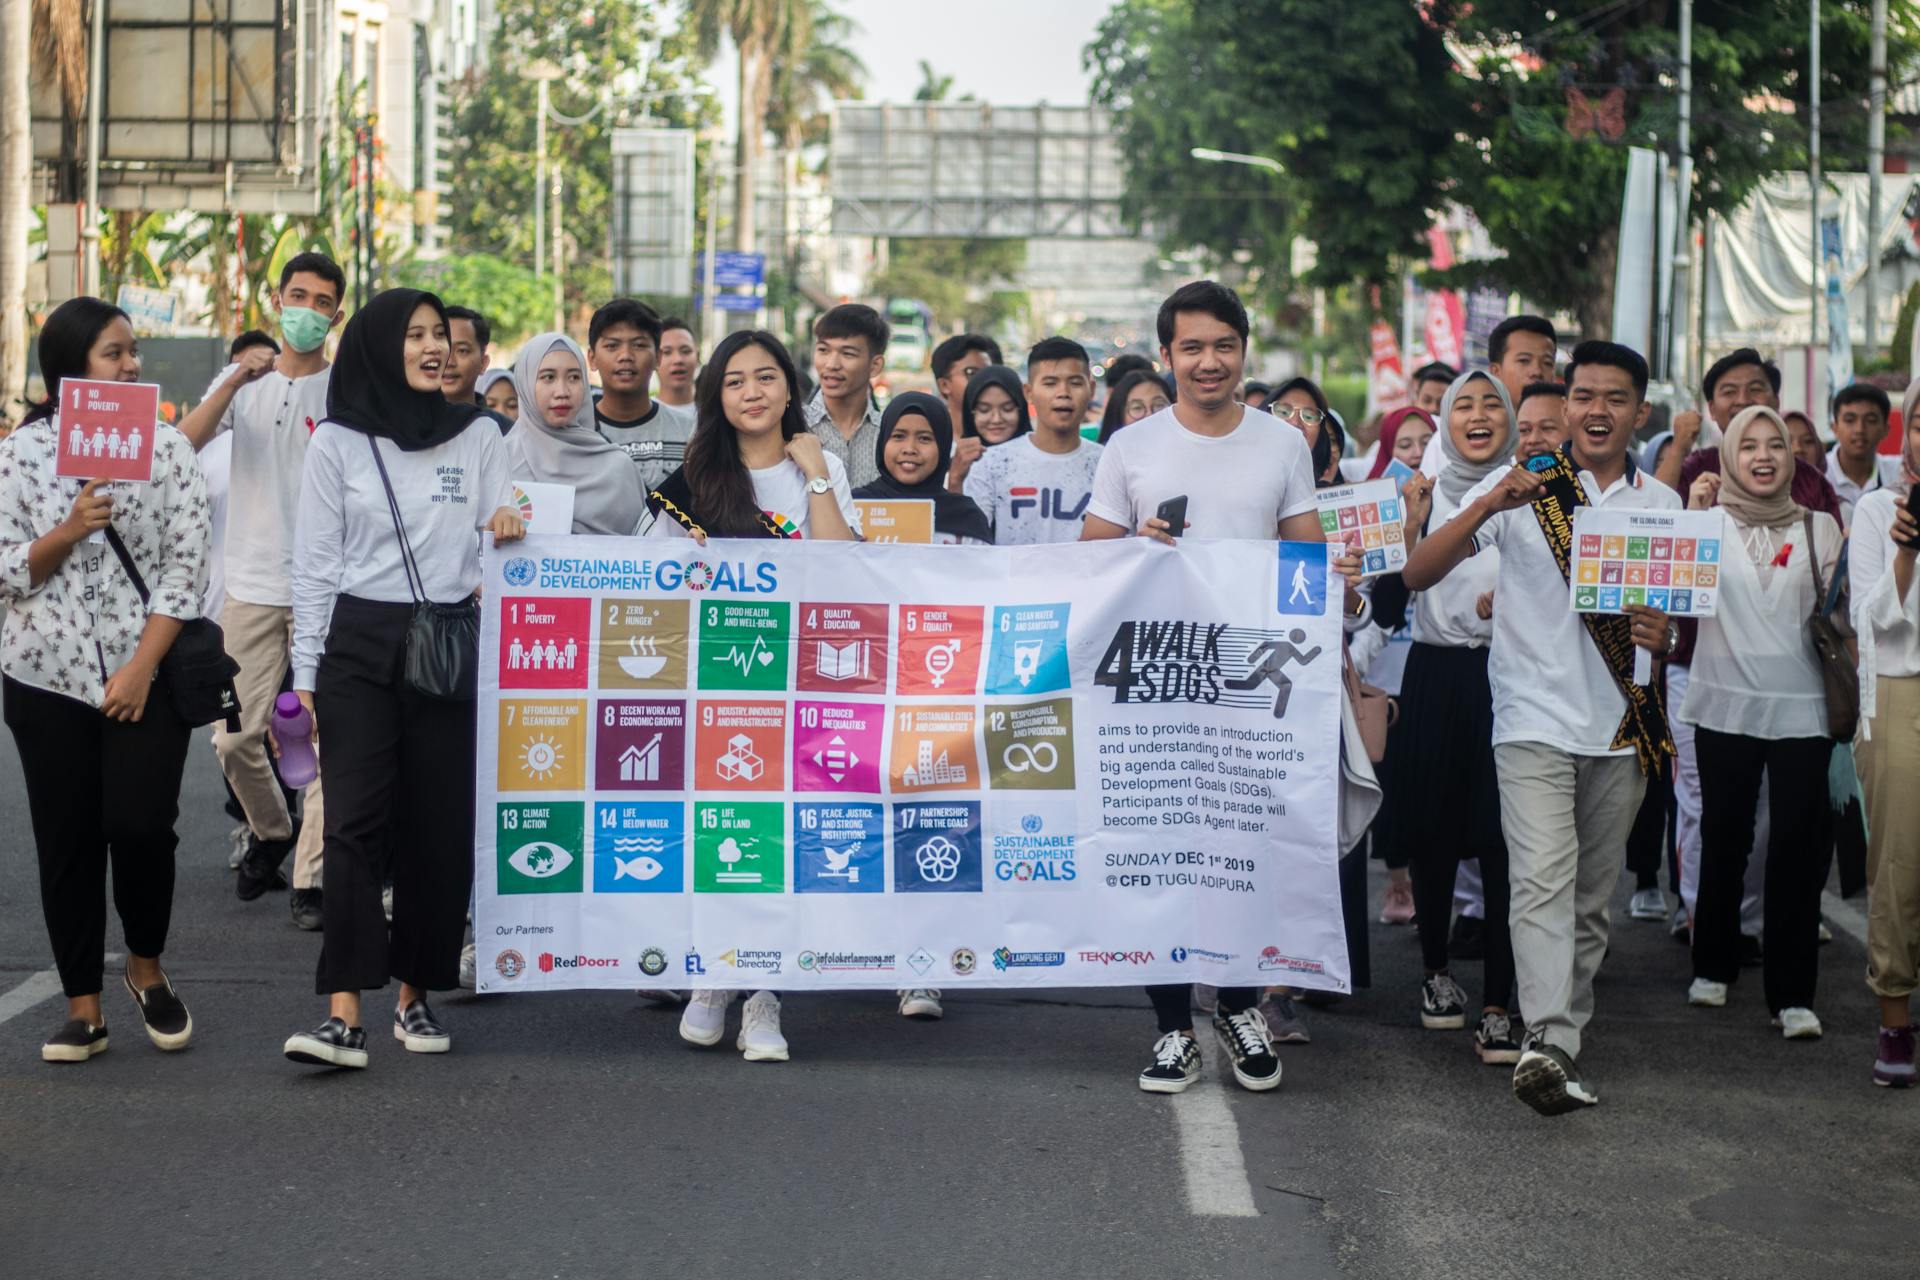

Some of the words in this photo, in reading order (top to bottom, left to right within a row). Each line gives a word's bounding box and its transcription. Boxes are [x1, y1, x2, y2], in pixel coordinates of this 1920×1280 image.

[73, 388, 79, 409] 1
[89, 390, 99, 398] NO
[88, 401, 119, 411] POVERTY
[437, 466, 464, 476] please
[1542, 468, 1558, 481] ARA
[442, 476, 460, 485] stop
[1639, 517, 1657, 525] GLOBAL
[541, 559, 652, 574] SUSTAINABLE
[655, 560, 777, 593] GOALS
[540, 576, 650, 590] DEVELOPMENT
[510, 604, 518, 624] 1
[526, 604, 536, 613] NO
[626, 606, 643, 615] ZERO
[725, 607, 744, 616] GOOD
[745, 608, 769, 617] HEALTH
[525, 615, 555, 624] POVERTY
[608, 605, 618, 625] 2
[708, 606, 718, 626] 3
[806, 610, 817, 629] 4
[824, 610, 851, 619] QUALITY
[923, 611, 947, 621] GENDER
[1016, 611, 1033, 621] CLEAN
[1034, 610, 1054, 620] WATER
[626, 616, 652, 626] HUNGER
[724, 618, 738, 627] AND
[739, 618, 777, 628] WELL-BEING
[824, 620, 860, 629] EDUCATION
[906, 612, 916, 632] 5
[1001, 613, 1010, 632] 6
[1015, 621, 1029, 632] AND
[923, 623, 952, 632] EQUALITY
[1600, 620, 1625, 671] TAHUN
[1094, 621, 1140, 703] 4
[1135, 620, 1229, 663] WALK
[1137, 663, 1221, 704] SDGS
[507, 706, 515, 726] 7
[523, 706, 564, 715] AFFORDABLE
[564, 706, 578, 715] AND
[605, 706, 614, 726] 8
[620, 706, 645, 715] DECENT
[646, 706, 664, 715] WORK
[666, 706, 680, 715] AND
[748, 707, 784, 716] INNOVATION
[823, 708, 854, 719] REDUCED
[1011, 705, 1054, 720] RESPONSIBLE
[523, 717, 545, 726] CLEAN
[545, 717, 569, 726] ENERGY
[620, 717, 654, 726] ECONOMIC
[654, 717, 682, 726] GROWTH
[703, 707, 713, 726] 9
[717, 717, 731, 726] AND
[731, 718, 782, 727] INFRASTRUCTURE
[800, 708, 817, 728] 10
[900, 712, 912, 732] 11
[990, 711, 1005, 732] 12
[822, 719, 866, 730] INEQUALITIES
[1012, 716, 1057, 729] CONSUMPTION
[1013, 728, 1028, 738] AND
[1028, 726, 1066, 737] PRODUCTION
[1098, 724, 1131, 736] aims
[1136, 723, 1148, 736] to
[1153, 722, 1200, 738] provide
[1204, 726, 1218, 736] an
[1220, 726, 1293, 742] introduction
[1100, 742, 1124, 754] and
[1129, 742, 1219, 758] understanding
[1222, 744, 1232, 756] of
[1235, 746, 1252, 760] the
[1256, 748, 1304, 762] world's
[1100, 760, 1120, 775] big
[1125, 761, 1176, 776] agenda
[1181, 760, 1214, 774] called
[1218, 762, 1287, 781] Sustainable
[1101, 778, 1191, 792] Development
[1195, 777, 1226, 792] Goals
[1230, 782, 1276, 799] (SDGs).
[1103, 796, 1183, 810] Participants
[1188, 795, 1198, 806] of
[1202, 797, 1220, 810] this
[1224, 800, 1262, 815] parade
[1267, 804, 1286, 816] will
[523, 809, 550, 818] CLIMATE
[600, 808, 617, 828] 14
[623, 808, 636, 818] LIFE
[722, 809, 735, 818] LIFE
[821, 809, 844, 819] PEACE,
[846, 809, 872, 818] JUSTICE
[920, 808, 968, 817] PARTNERSHIPS
[502, 809, 518, 829] 13
[523, 819, 546, 829] ACTION
[623, 819, 645, 828] BELOW
[646, 819, 669, 828] WATER
[700, 809, 718, 828] 15
[722, 819, 731, 828] ON
[733, 819, 750, 828] LAND
[800, 808, 817, 829] 16
[821, 819, 836, 829] AND
[836, 820, 863, 829] STRONG
[900, 808, 914, 829] 17
[920, 819, 931, 828] FOR
[933, 819, 945, 828] THE
[947, 819, 968, 828] GOALS
[1104, 814, 1158, 826] become
[1162, 812, 1200, 825] SDGs
[1204, 816, 1235, 832] Agent
[1238, 818, 1268, 833] later.
[821, 830, 866, 840] INSTITUTIONS
[994, 836, 1074, 847] SUSTAINABLE
[994, 850, 1074, 860] DEVELOPMENT
[1105, 852, 1172, 867] SUNDAY
[1175, 852, 1204, 865] DEC
[1224, 859, 1254, 872] 2019
[995, 861, 1076, 881] GOALS
[1156, 873, 1198, 886] TUGU
[1200, 876, 1255, 892] ADIPURA
[496, 926, 512, 936] Our
[516, 925, 554, 935] Partners
[737, 949, 781, 960] Lampung
[1012, 952, 1043, 962] LAMPUNG
[1045, 953, 1058, 962] GEH
[1078, 952, 1154, 966] TEKNOKRA
[554, 956, 619, 968] RedDoorz
[737, 960, 781, 968] Directory
[817, 952, 895, 969] infolokerlampung.net
